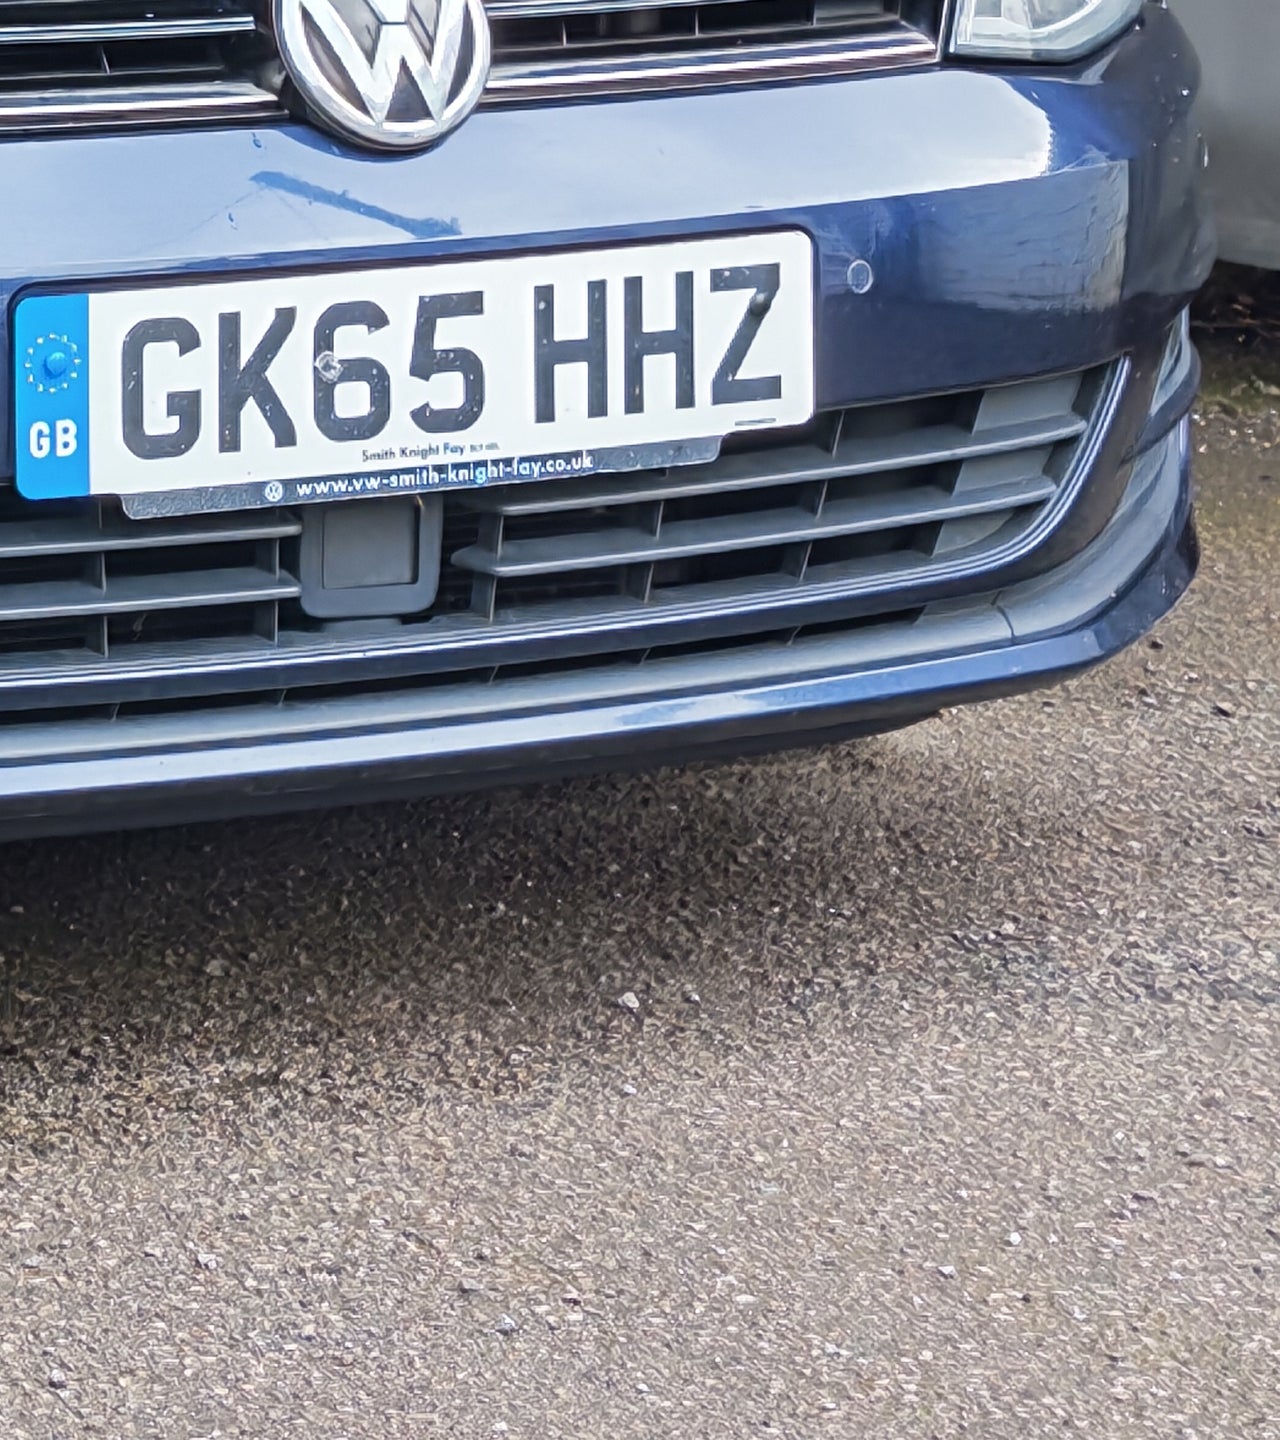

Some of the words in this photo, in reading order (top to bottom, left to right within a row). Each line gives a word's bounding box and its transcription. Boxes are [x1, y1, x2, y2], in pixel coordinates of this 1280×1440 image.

[121, 290, 487, 460] GK65
[534, 263, 782, 424] HHZ
[29, 418, 78, 459] GB
[362, 448, 396, 462] Smith
[399, 443, 439, 460] Knight
[443, 441, 466, 456] Fay
[295, 449, 594, 497] www.vw-smith-knight-fay.co.uk
